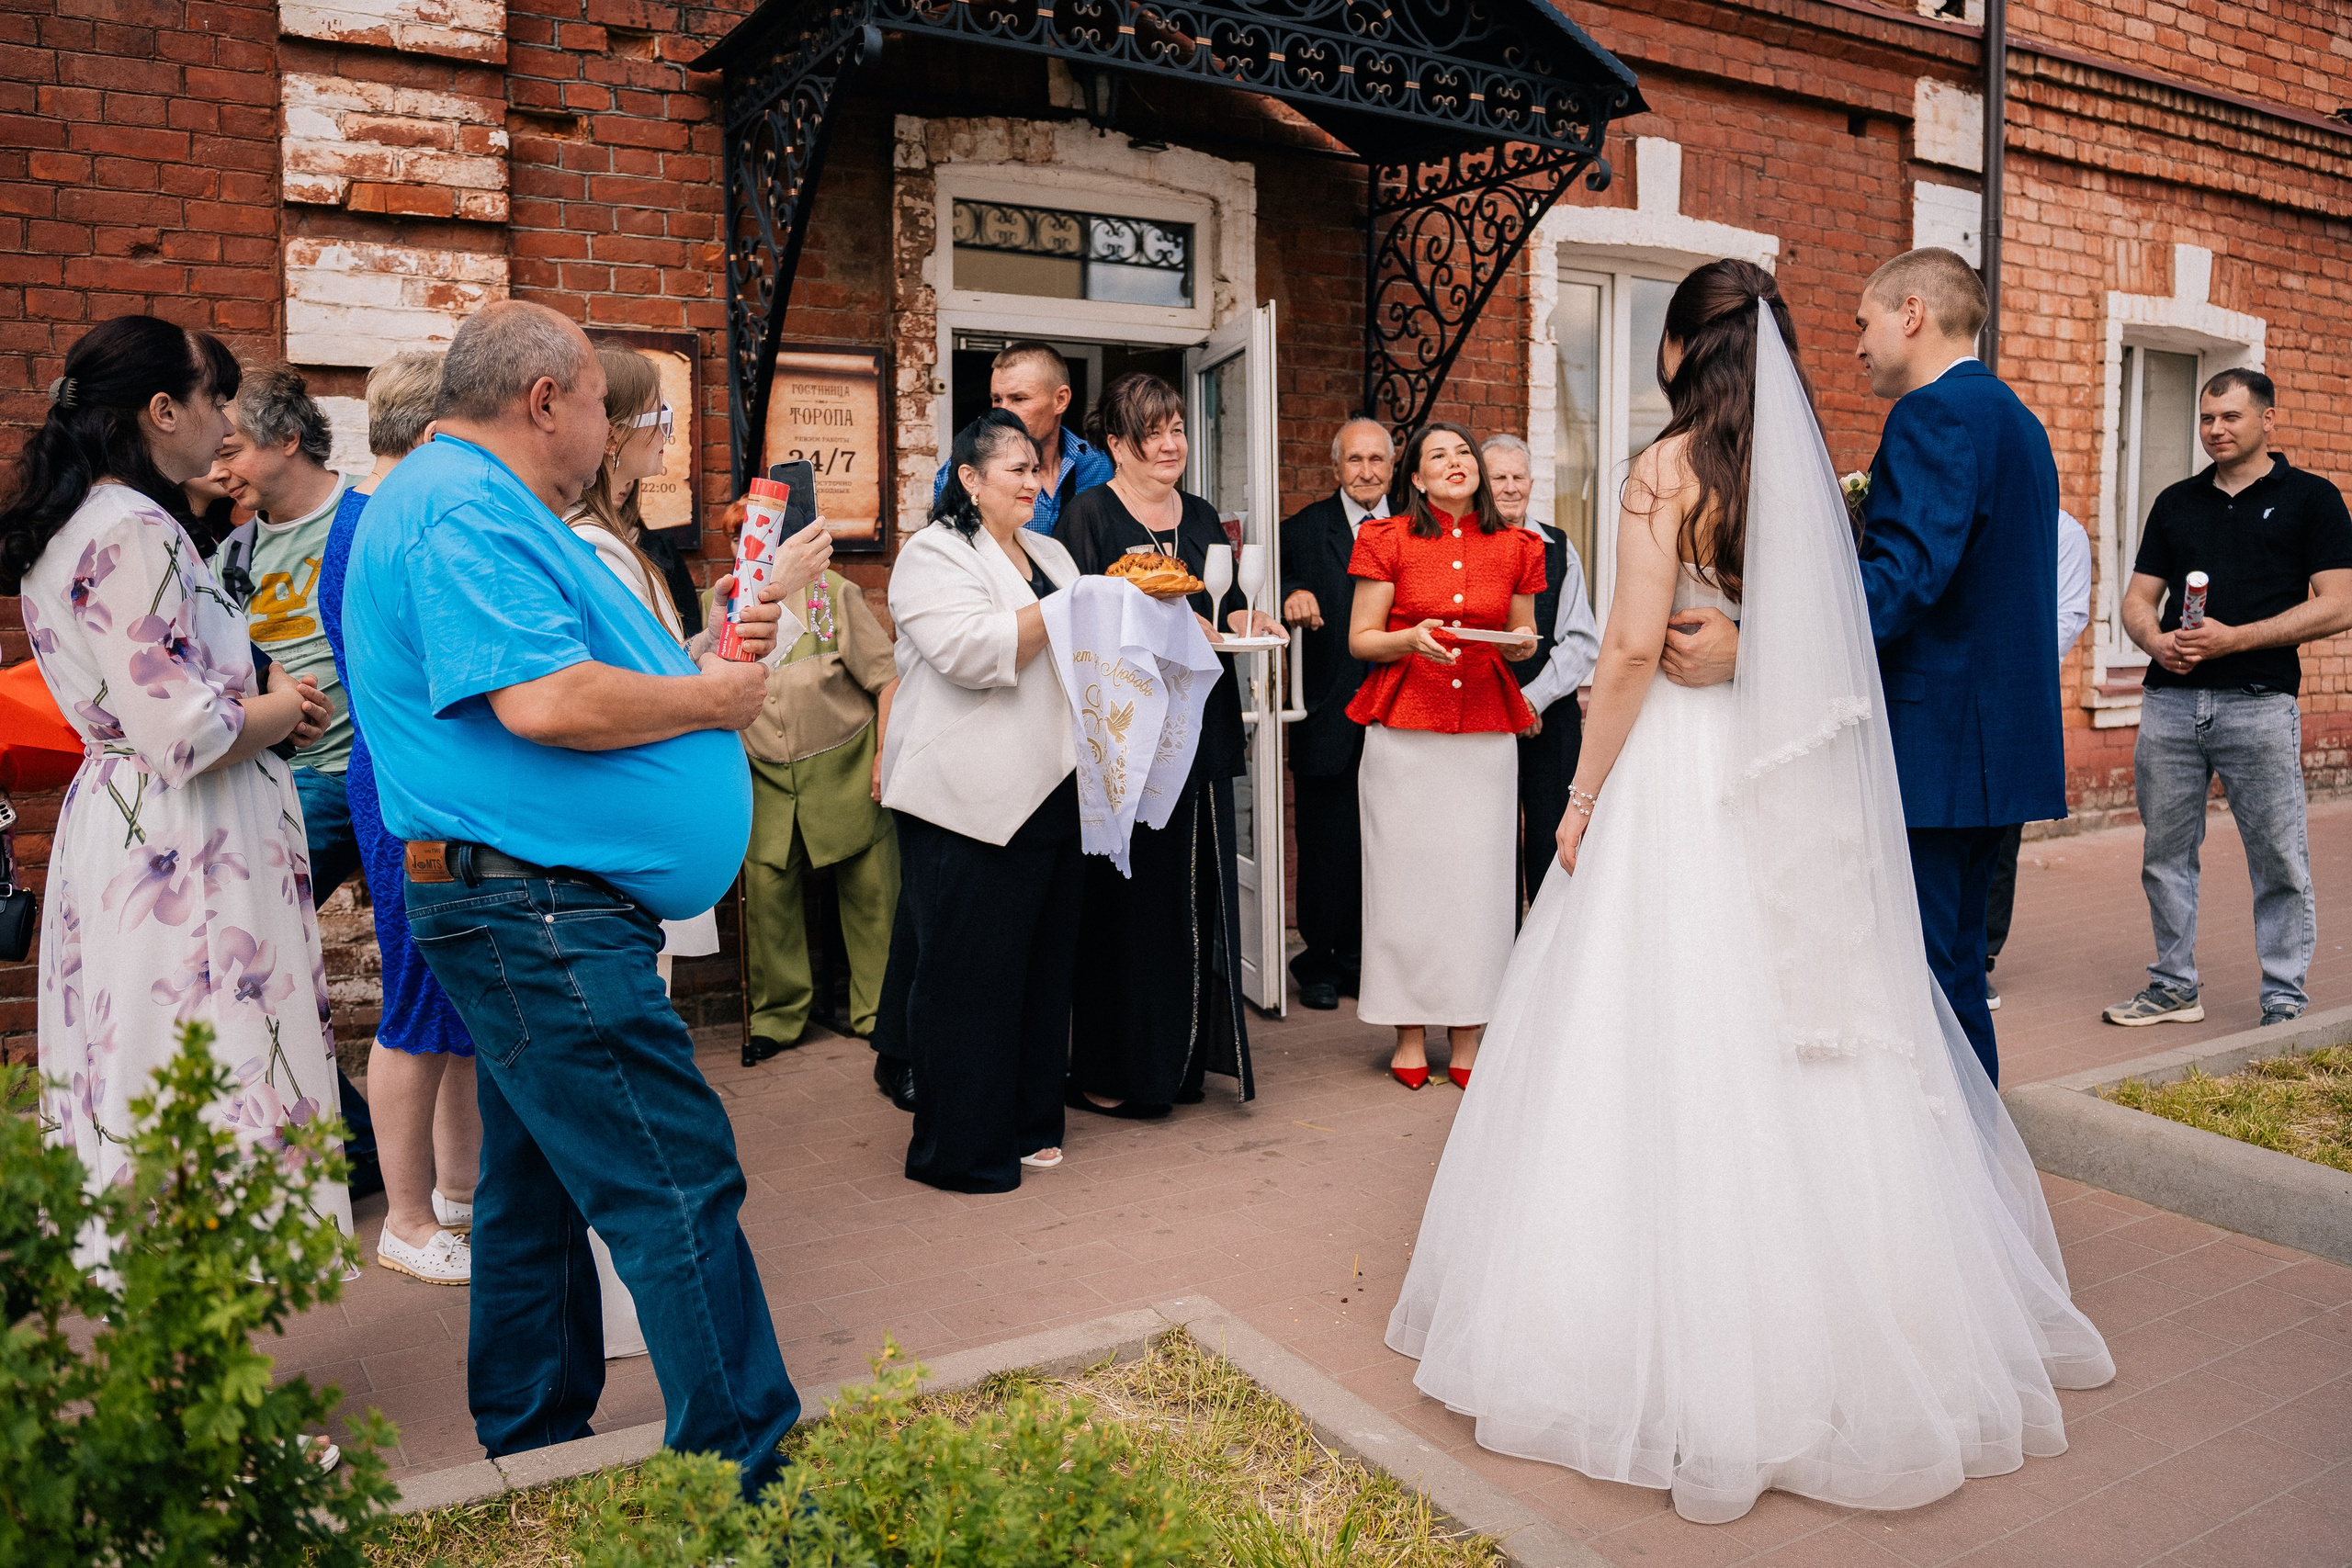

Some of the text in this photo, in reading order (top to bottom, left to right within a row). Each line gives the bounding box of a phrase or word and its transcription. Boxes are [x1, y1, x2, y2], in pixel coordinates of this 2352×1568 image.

[792, 383, 850, 398] ГОСТИНИЦА
[789, 407, 854, 426] ТОРОПА
[641, 482, 676, 493] 22:00
[1101, 657, 1154, 696] Любовь
